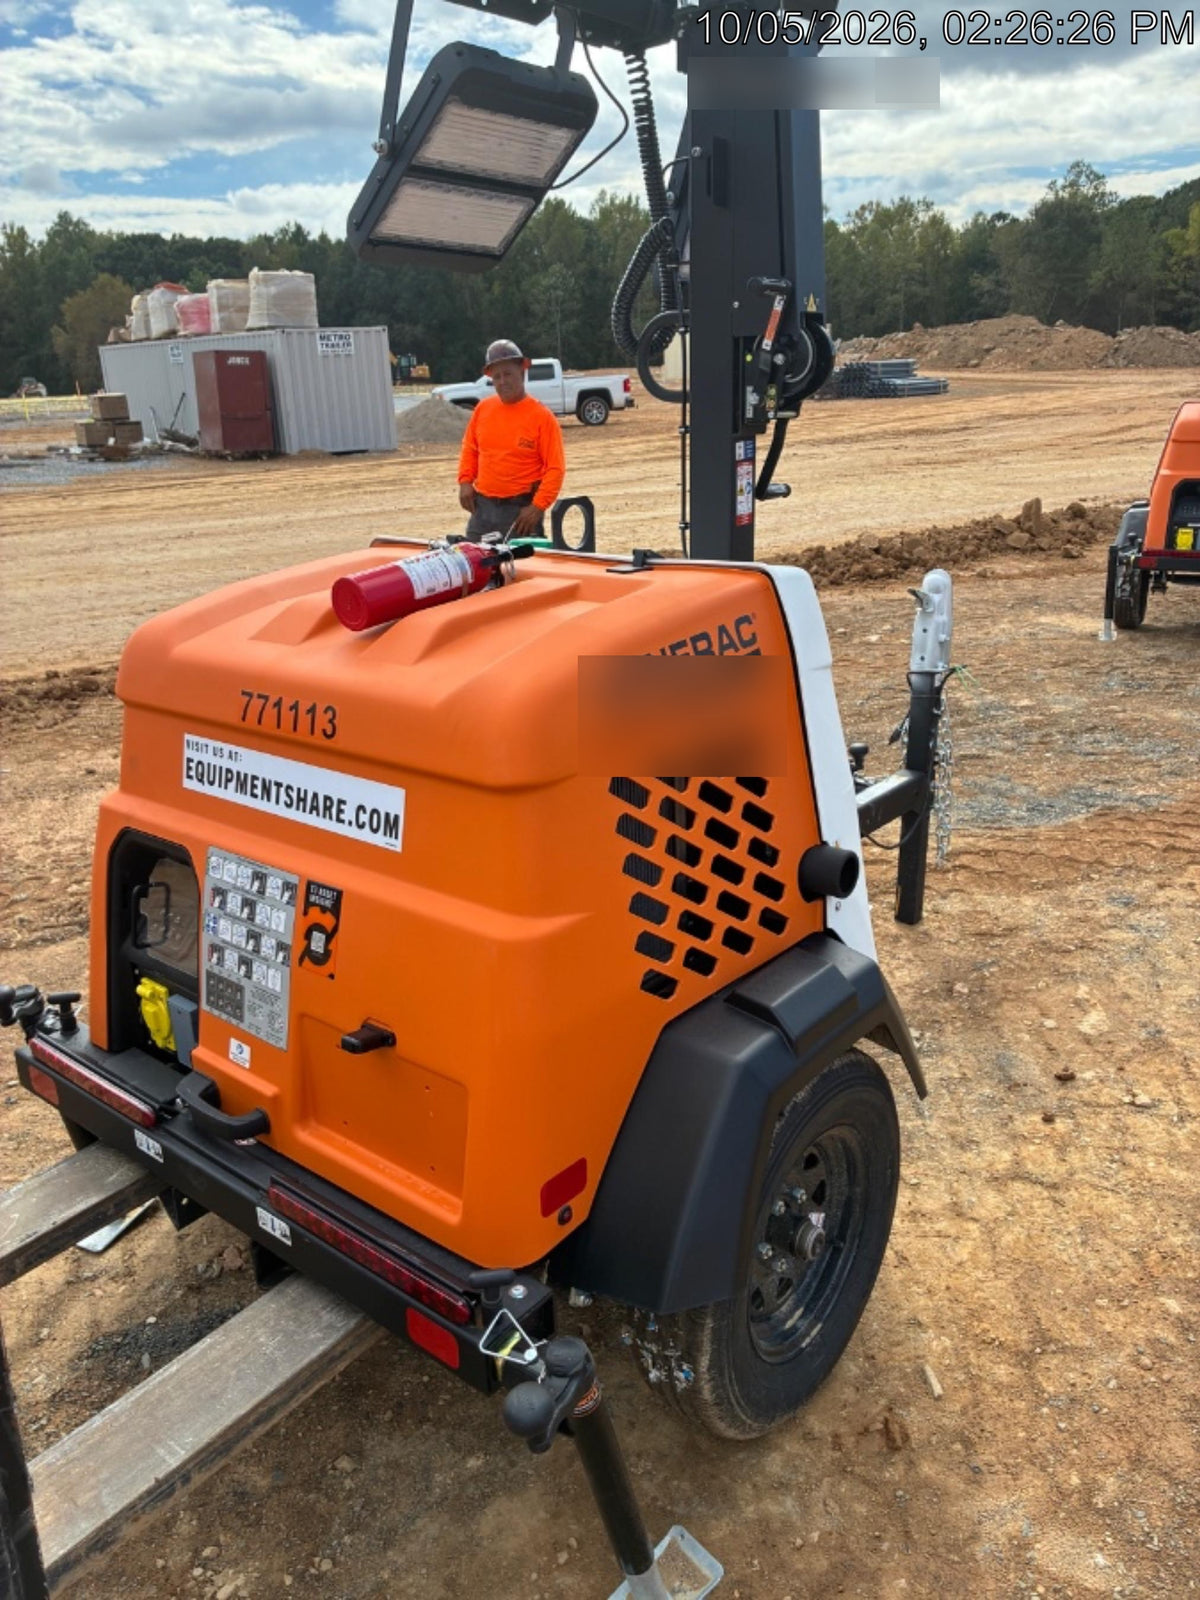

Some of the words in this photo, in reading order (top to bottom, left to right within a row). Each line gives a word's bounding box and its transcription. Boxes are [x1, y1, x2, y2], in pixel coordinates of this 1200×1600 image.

[240, 689, 338, 740] 771113
[185, 739, 210, 755] VISIT
[212, 745, 226, 759] US
[227, 749, 243, 763] AT:
[185, 756, 401, 841] EQUIPMENTSHARE.COM
